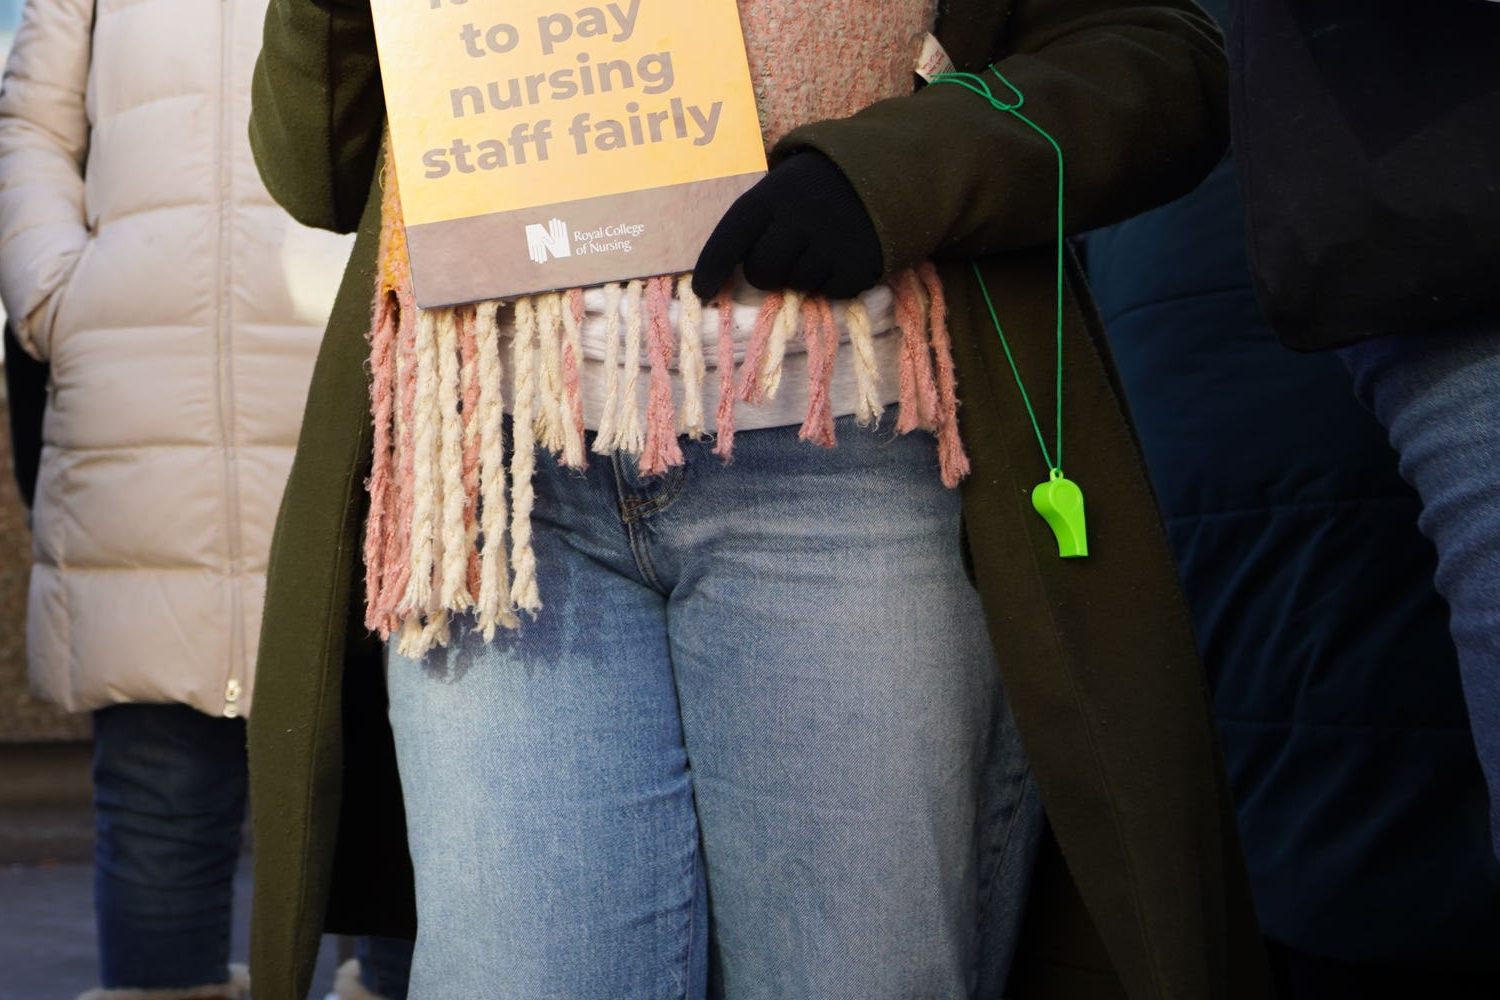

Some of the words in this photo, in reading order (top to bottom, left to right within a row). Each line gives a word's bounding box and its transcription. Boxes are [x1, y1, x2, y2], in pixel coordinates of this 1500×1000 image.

[459, 22, 520, 58] to
[450, 51, 675, 119] nursing
[422, 119, 552, 180] staff
[568, 97, 723, 156] fairly
[574, 227, 603, 244] Royal
[605, 223, 645, 237] College
[576, 245, 587, 256] of
[589, 239, 632, 253] Nursing
